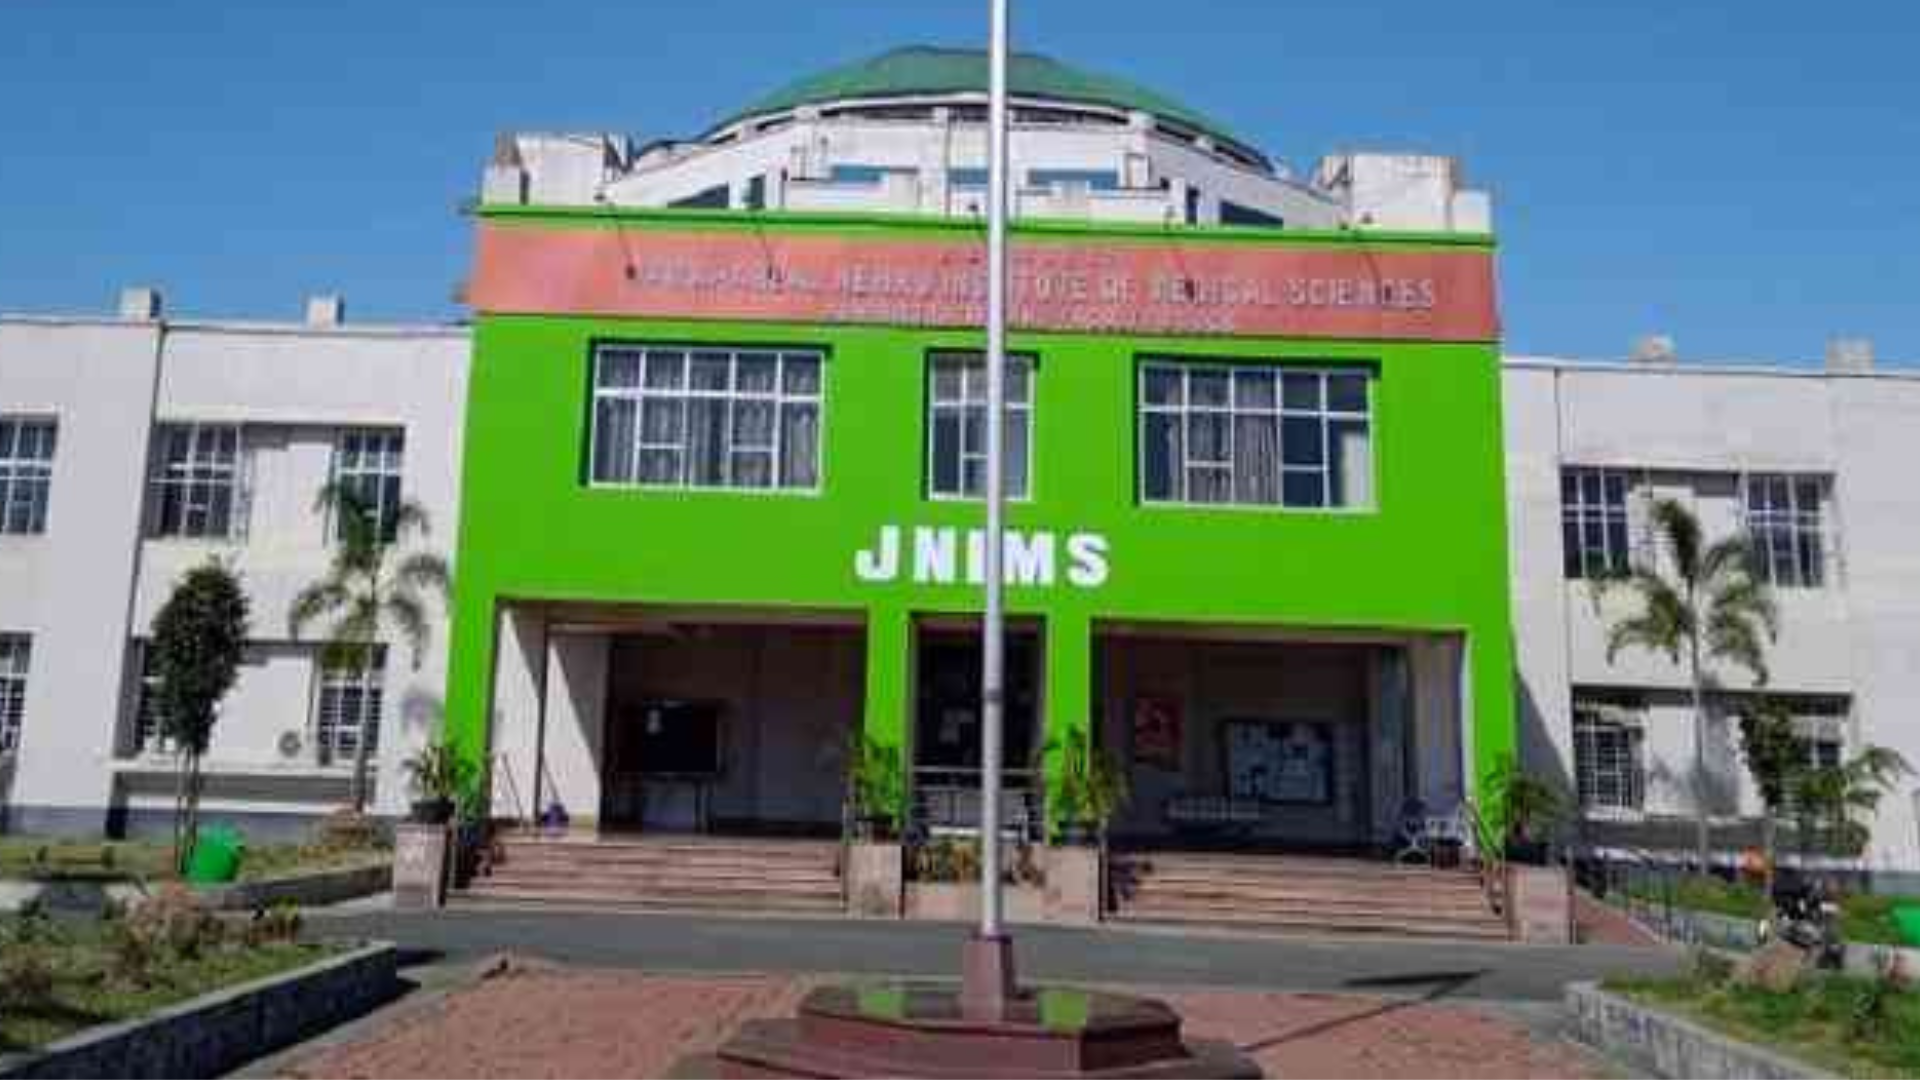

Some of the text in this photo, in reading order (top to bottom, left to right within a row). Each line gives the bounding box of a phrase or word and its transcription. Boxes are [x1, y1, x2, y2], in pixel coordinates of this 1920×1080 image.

[944, 269, 1087, 303] INSITUTE
[1098, 276, 1136, 304] OF
[1284, 279, 1435, 307] SCIENCES
[855, 525, 1109, 586] JNIMS
